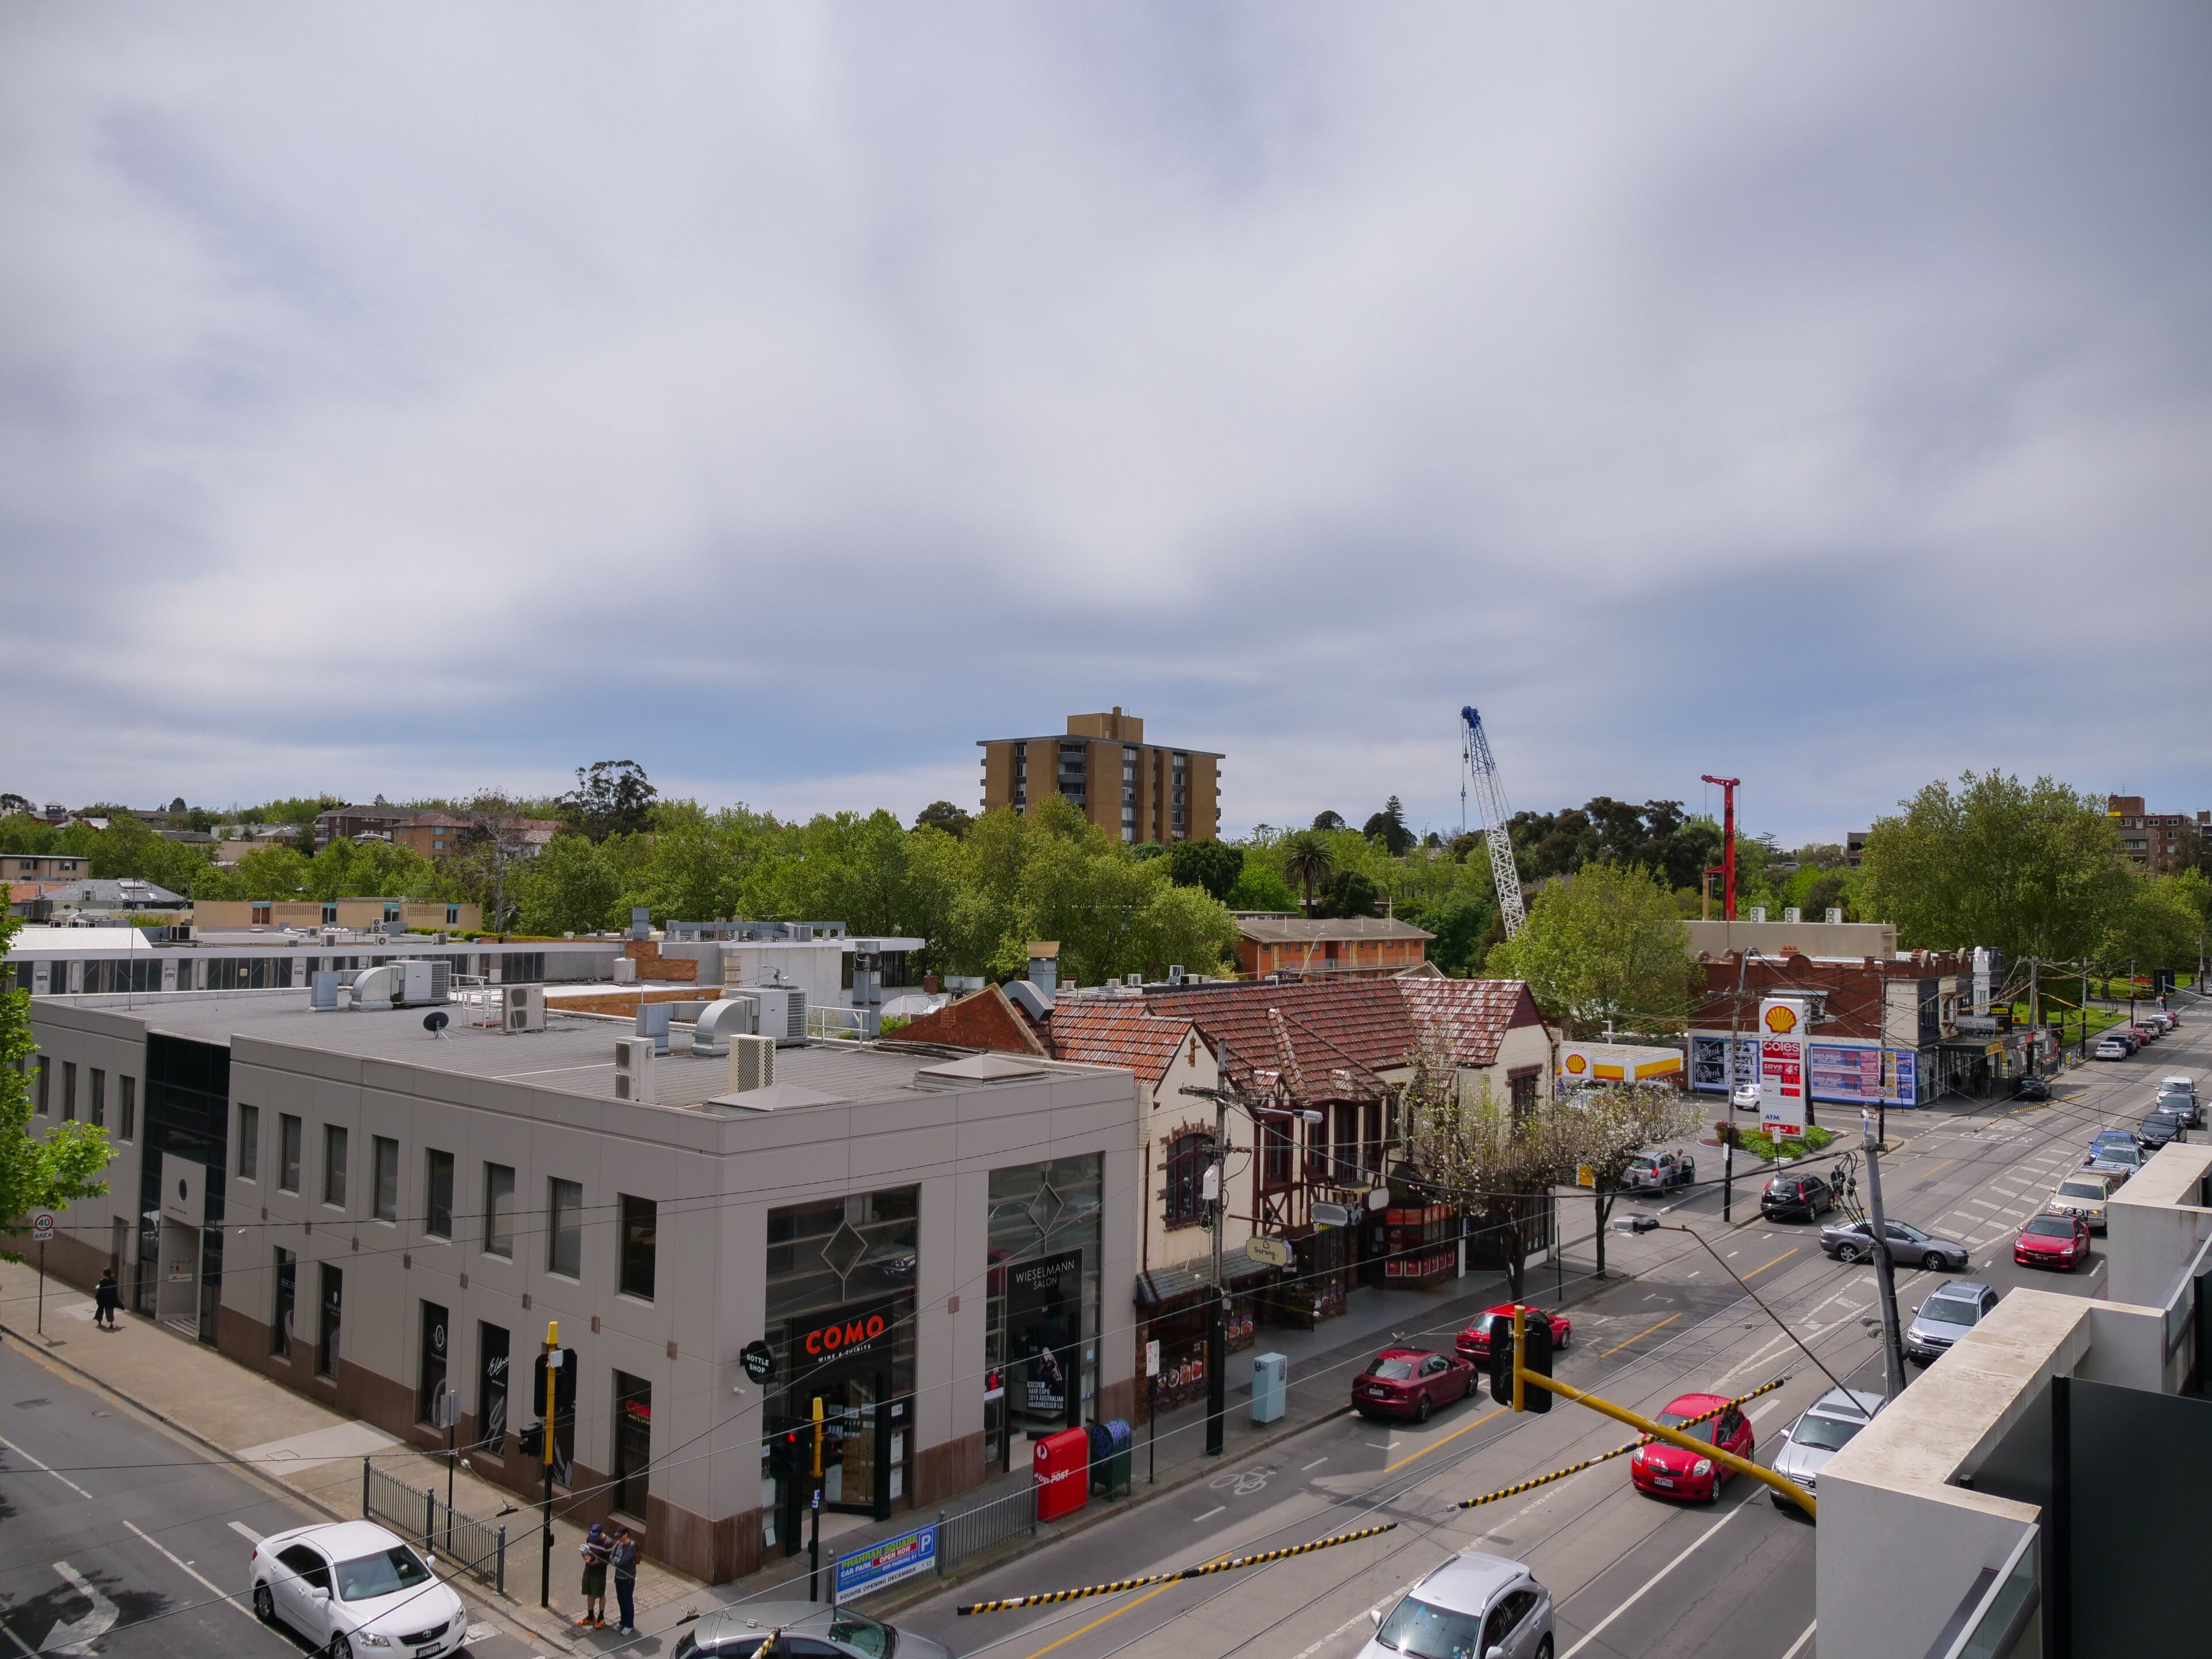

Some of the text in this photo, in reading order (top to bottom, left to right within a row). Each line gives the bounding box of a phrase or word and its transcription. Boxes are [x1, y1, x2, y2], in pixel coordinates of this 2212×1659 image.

[1763, 1041, 1800, 1052] coles
[37, 1218, 51, 1226] 40
[1254, 1246, 1275, 1260] Sarang
[1016, 1259, 1074, 1283] WIESELMANN
[1033, 1276, 1057, 1290] SALON
[806, 1315, 884, 1354] COMO
[747, 1354, 769, 1366] BOTTLE
[819, 1353, 835, 1362] WINE
[846, 1344, 871, 1355] SPIRITS
[749, 1363, 766, 1373] SHOP
[1051, 1469, 1069, 1483] POST
[884, 1534, 918, 1552] SQUARE
[921, 1534, 931, 1552] P
[841, 1569, 854, 1578] CAR
[855, 1561, 872, 1572] PARK
[879, 1552, 896, 1563] OPEN
[897, 1545, 911, 1555] NOW
[892, 1557, 910, 1568] PARKING
[839, 1588, 862, 1600] SQUARE
[863, 1579, 887, 1591] OPENING
[888, 1567, 916, 1582] DECEMBER
